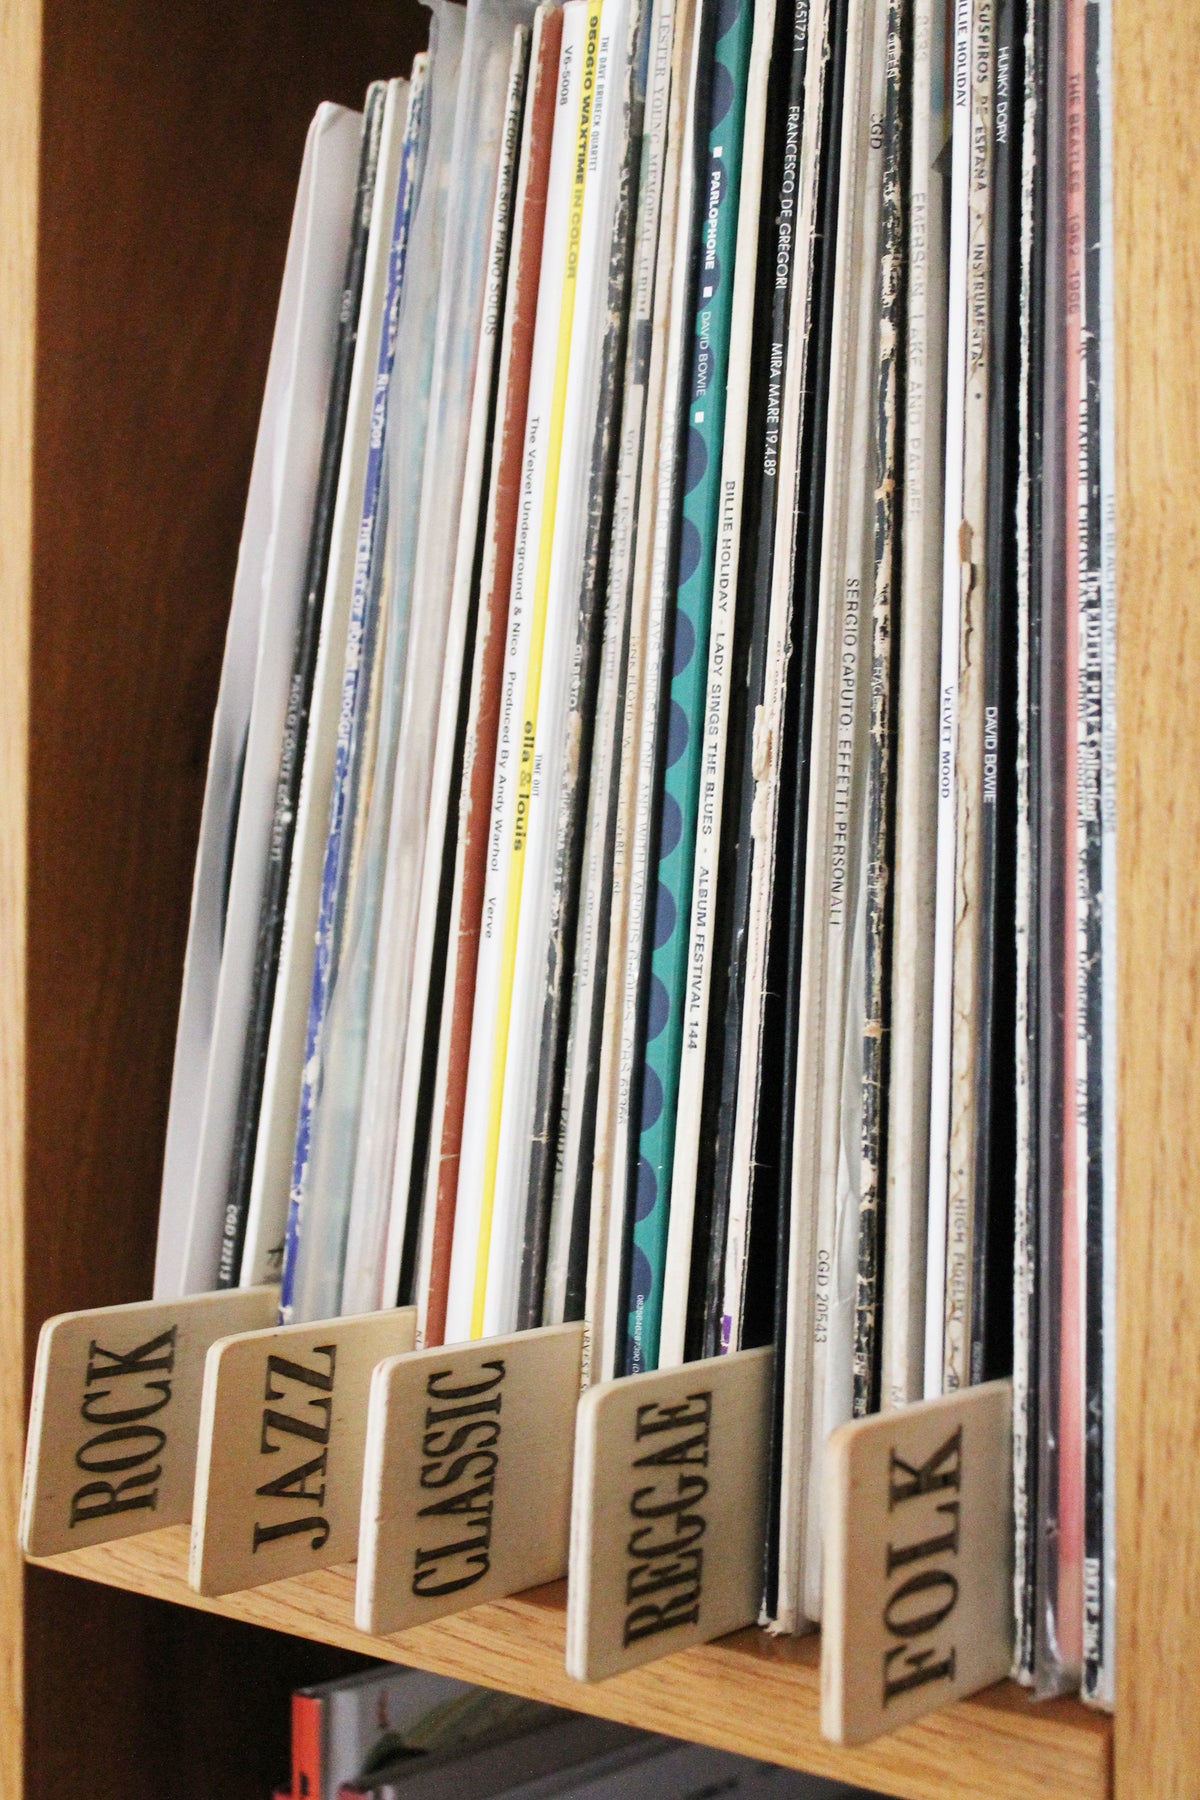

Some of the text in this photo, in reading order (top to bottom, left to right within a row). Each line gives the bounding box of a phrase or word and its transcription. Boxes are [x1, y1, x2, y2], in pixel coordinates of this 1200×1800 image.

[558, 45, 574, 106] V6-5008
[954, 0, 967, 108] ILLIE HOLIDAY
[976, 3, 990, 84] SUSPIROS
[589, 36, 610, 172] THE DAVE BRUBECK QUARTET
[995, 46, 1009, 144] HUNKY DORY
[497, 163, 513, 225] WILSON
[566, 15, 599, 280] 950610 WAXTIME IN COLOR
[781, 106, 800, 193] FRANCESCO
[1068, 114, 1081, 193] BEATLES
[491, 229, 507, 279] PIANO
[775, 223, 790, 289] GREGORI
[780, 199, 792, 217] DE
[484, 283, 500, 336] SOLOS
[695, 170, 721, 398] PARLOPHONE DAVID BOWIE
[766, 384, 780, 423] MARE
[769, 343, 783, 379] MIRA
[762, 429, 778, 477] 19.4.89
[484, 417, 540, 940] The Velvet Underground & Nico Produced By Andy Warhol Verve
[513, 720, 535, 852] ella & louis
[531, 754, 544, 798] TIME OUT
[687, 480, 736, 1050] BILLIE HOLIDAY LADY SINGS THE BLUES ALBUM FESTIVAL 144
[829, 578, 859, 926] SERGIO CAPUTO: EFFETTI PERSONALI
[940, 686, 954, 800] VELVET MOOD
[983, 706, 998, 803] DAVID BOWIE
[223, 1204, 238, 1236] CGD
[953, 1198, 966, 1243] HIGH
[812, 1249, 830, 1344] CGD 20543
[70, 1324, 178, 1529] ROCK
[252, 1344, 338, 1555] JAZZ
[412, 1360, 506, 1598] CLASSIC
[623, 1391, 712, 1649] REGGAE
[882, 1424, 963, 1708] FOLK
